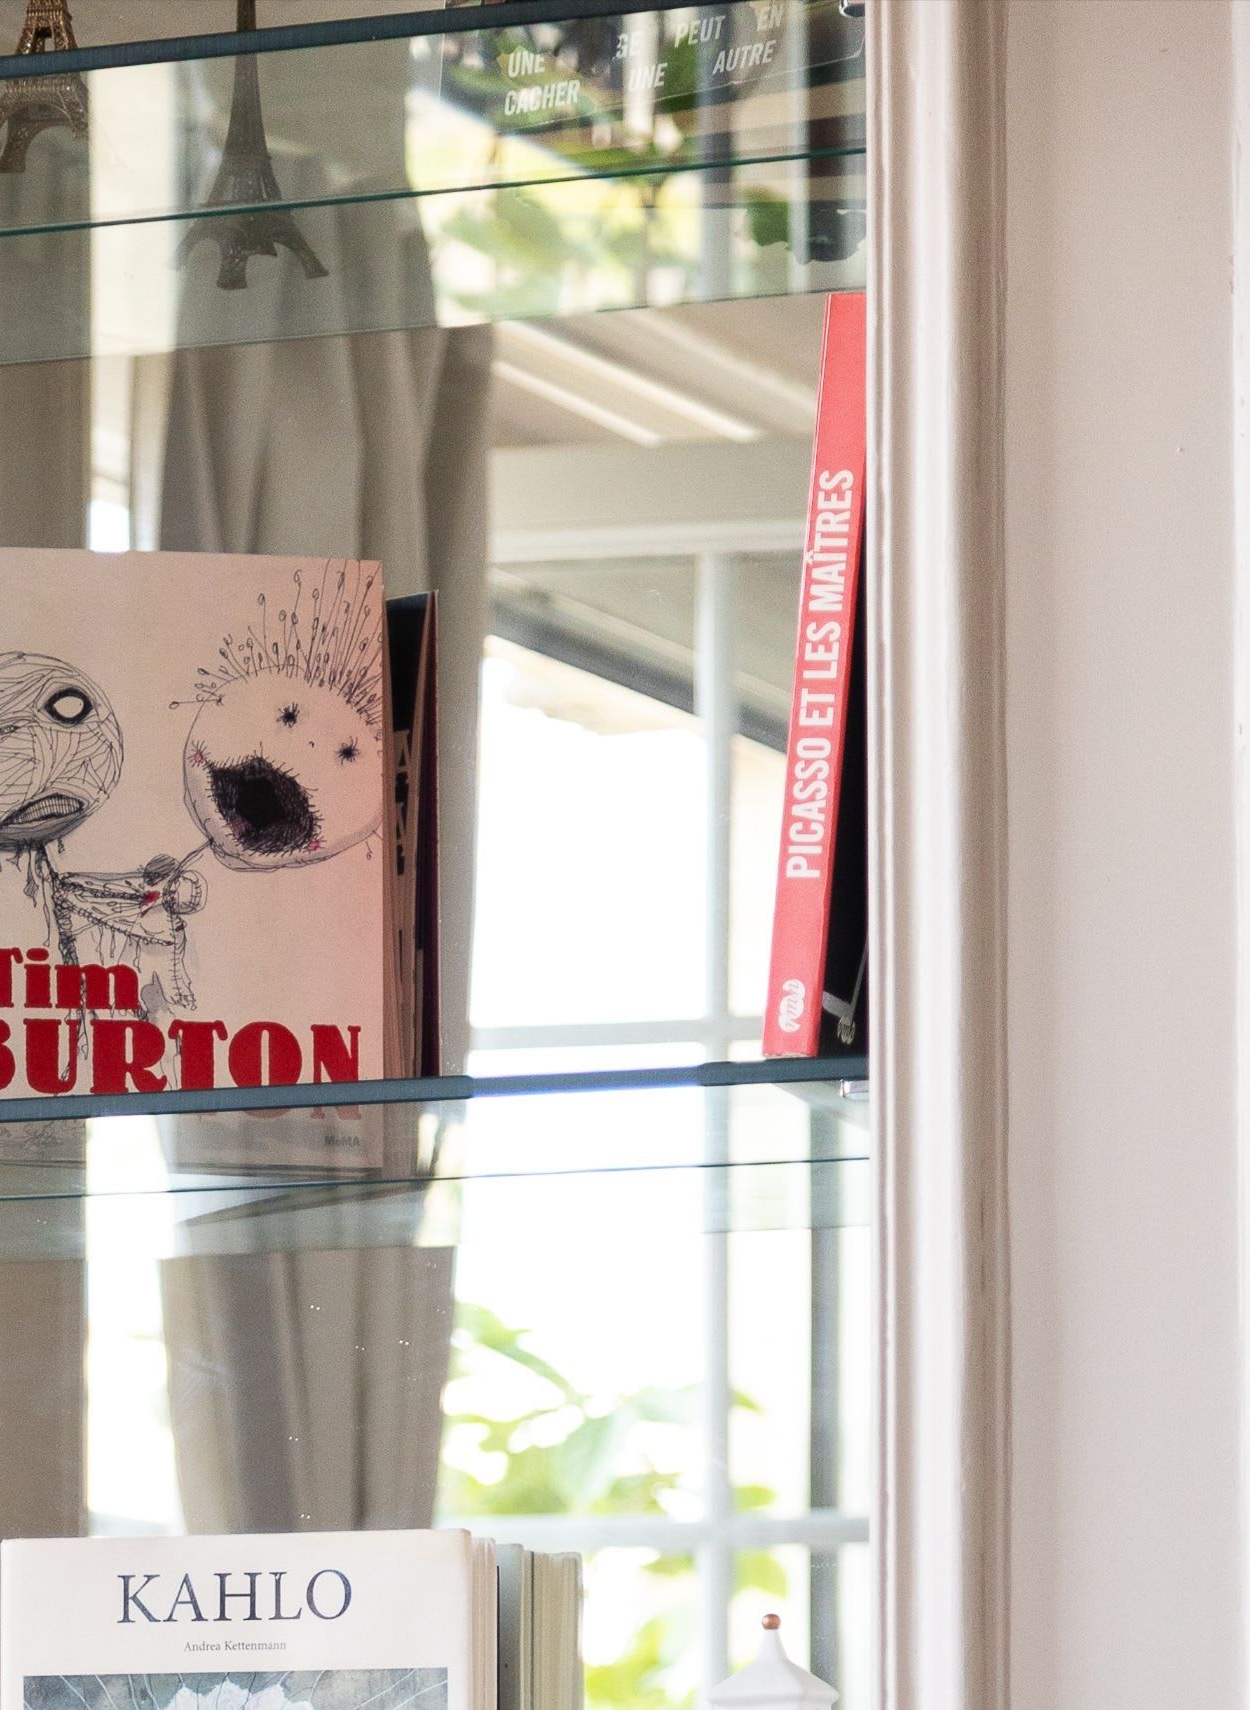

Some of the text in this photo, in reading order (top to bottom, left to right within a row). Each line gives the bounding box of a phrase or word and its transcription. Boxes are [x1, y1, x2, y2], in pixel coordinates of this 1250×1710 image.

[504, 39, 777, 117] CACHER UNE AUTRE
[508, 50, 546, 79] UNE
[674, 15, 727, 49] PEUT
[756, 4, 784, 32] EN
[785, 468, 854, 880] PICASSO ET LES MAÎTRES
[117, 1568, 353, 1625] KAHLO
[184, 1638, 287, 1653] Andrea Kettenmann
